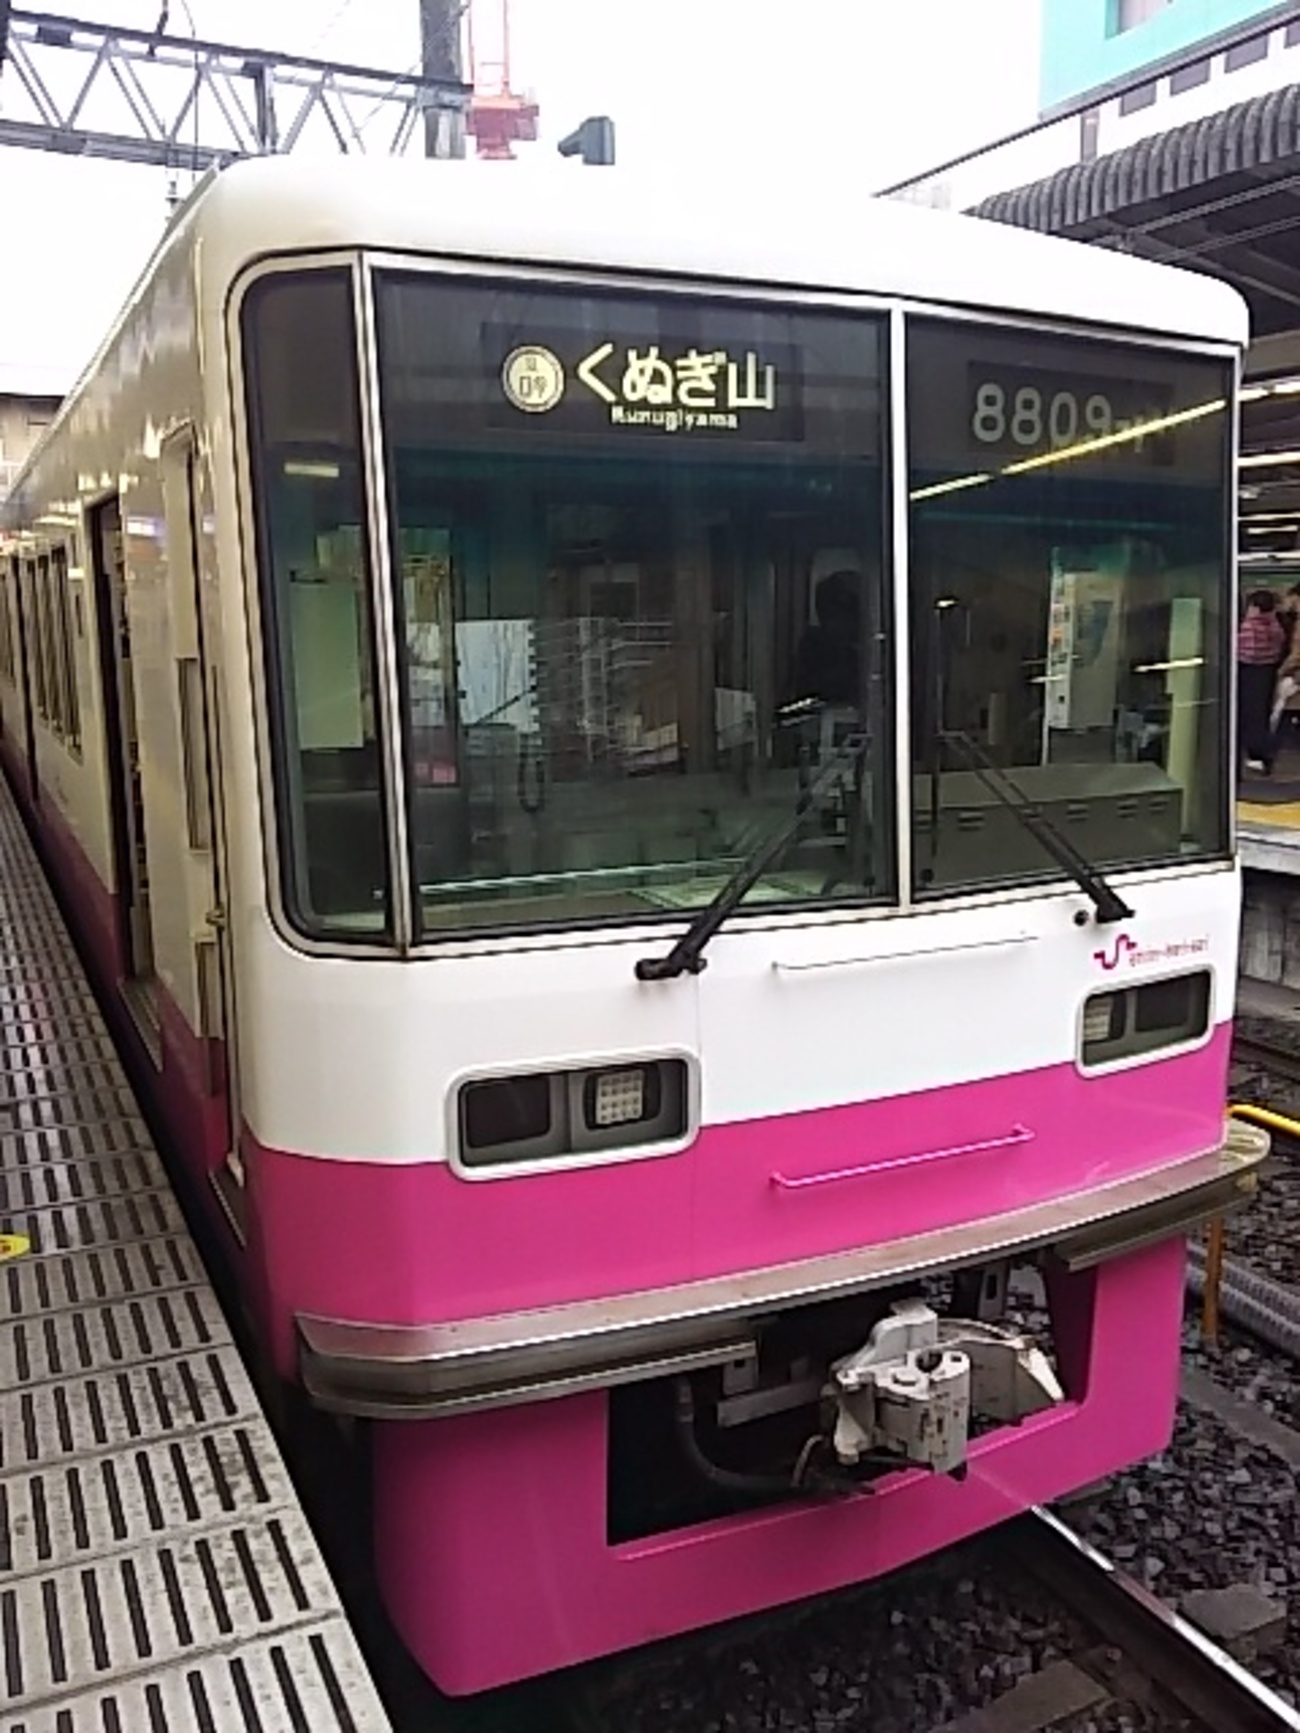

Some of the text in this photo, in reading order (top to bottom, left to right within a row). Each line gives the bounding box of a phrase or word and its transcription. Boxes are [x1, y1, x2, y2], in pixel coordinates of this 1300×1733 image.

[577, 343, 775, 409] くぬぎ山
[611, 405, 738, 432] Kunugiyama
